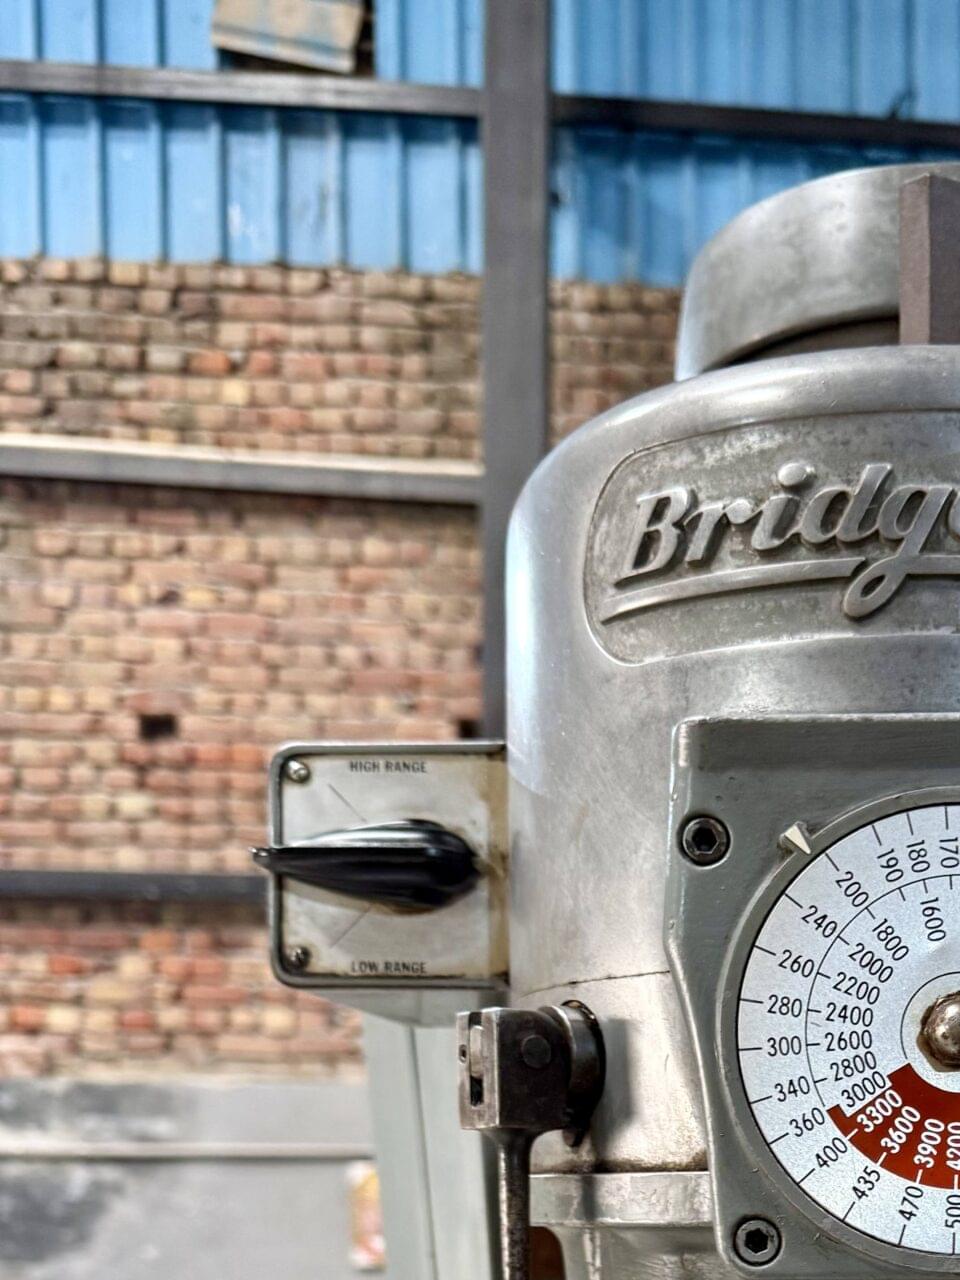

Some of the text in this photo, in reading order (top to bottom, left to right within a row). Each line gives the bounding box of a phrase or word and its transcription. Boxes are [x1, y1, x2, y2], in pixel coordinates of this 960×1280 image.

[350, 762, 427, 773] HIGH RANGE
[877, 849, 904, 882] 190
[907, 840, 930, 872] 180
[939, 837, 960, 868] 170
[836, 872, 869, 908] 200
[801, 905, 837, 938] 240
[921, 897, 946, 942] 1600
[872, 919, 909, 961] 1800
[351, 962, 427, 973] LOW RANGE
[778, 950, 814, 977] 260
[849, 943, 893, 982] 2000
[833, 972, 880, 1004] 2200
[768, 995, 801, 1017] 280
[825, 1003, 873, 1027] 2400
[767, 1036, 801, 1056] 300
[825, 1030, 872, 1051] 2600
[830, 1051, 877, 1081] 2800
[775, 1076, 810, 1102] 340
[841, 1071, 886, 1107] 3000
[790, 1108, 825, 1137] 360
[857, 1090, 902, 1132] 3300
[881, 1106, 920, 1153] 3600
[914, 1119, 945, 1168] 3900
[815, 1137, 848, 1168] 400
[852, 1166, 880, 1200] 435
[899, 1186, 924, 1221] 470
